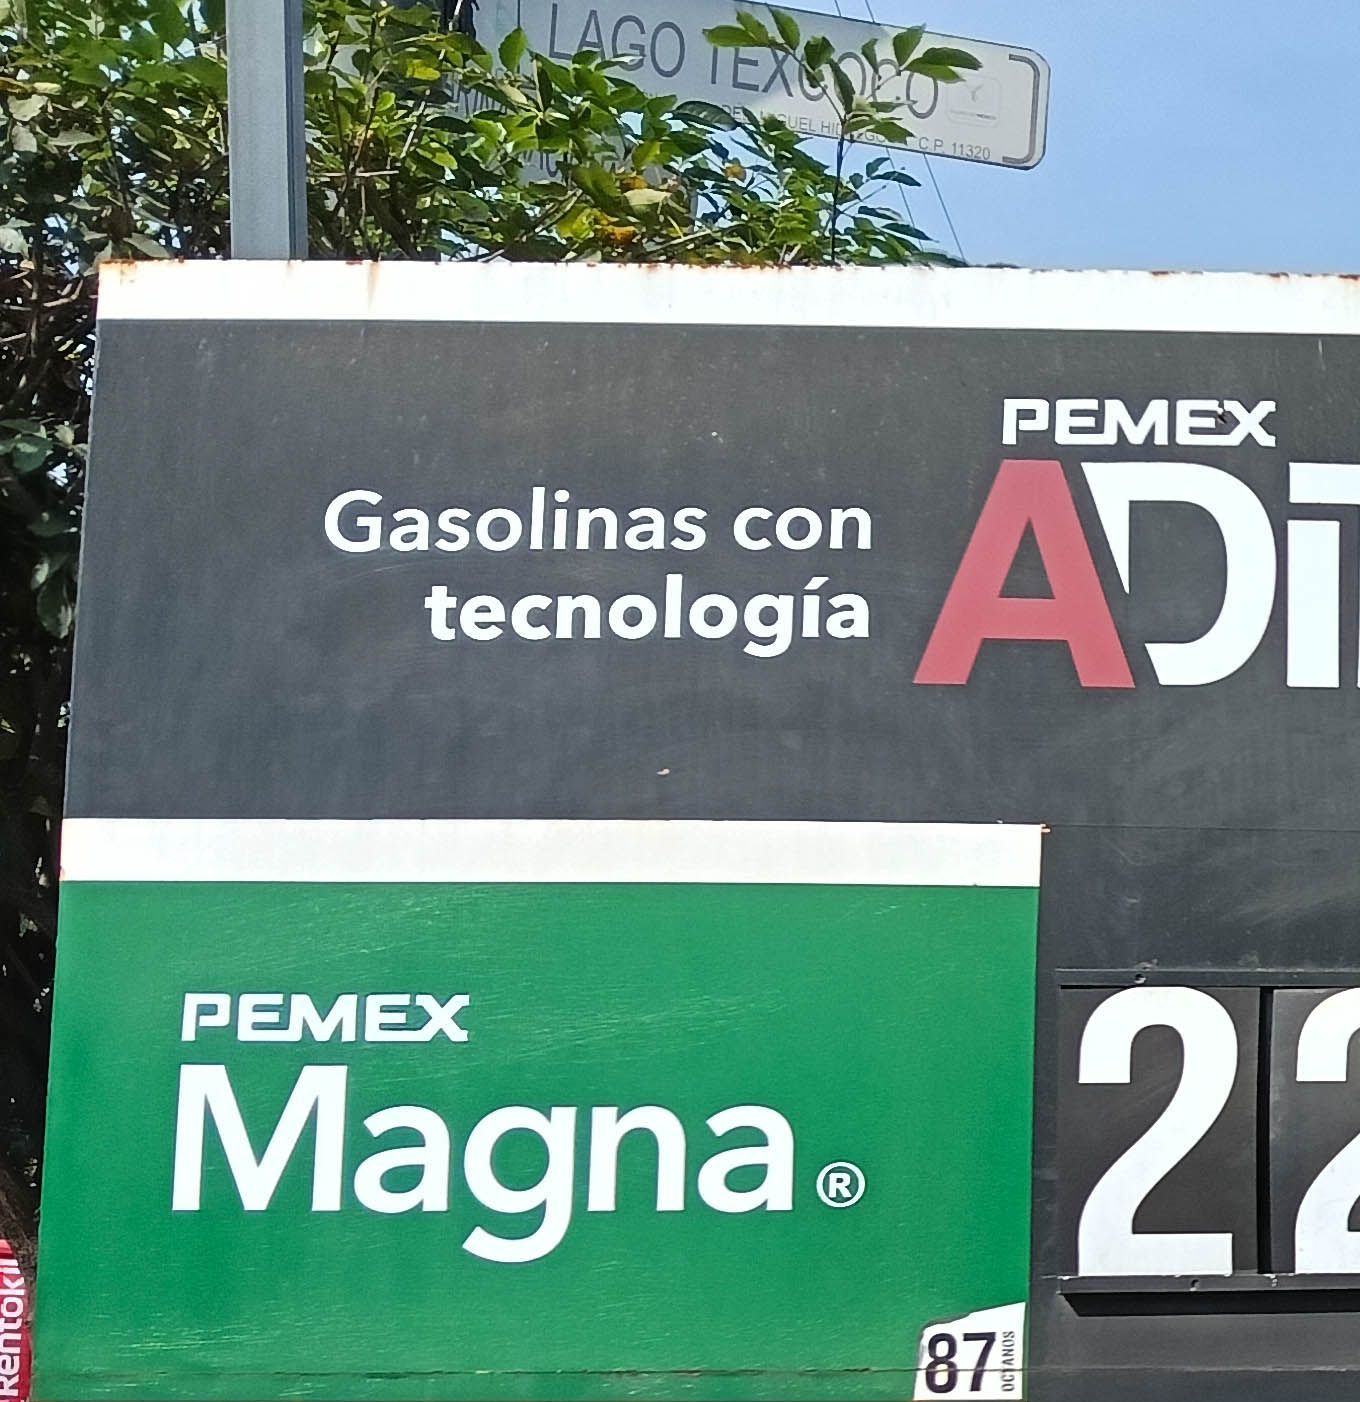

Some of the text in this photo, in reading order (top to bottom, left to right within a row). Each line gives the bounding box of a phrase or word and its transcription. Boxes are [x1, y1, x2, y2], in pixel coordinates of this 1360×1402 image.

[548, 3, 686, 78] LAGO
[951, 142, 991, 160] 11320
[1002, 398, 1276, 447] PEMEX
[324, 486, 872, 553] Gasolinas con
[424, 573, 869, 658] tecnología
[181, 993, 470, 1042] PEMEX
[172, 1064, 794, 1263] Magna
[925, 1332, 997, 1394] 87
[1000, 1331, 1016, 1393] OCTANOS
